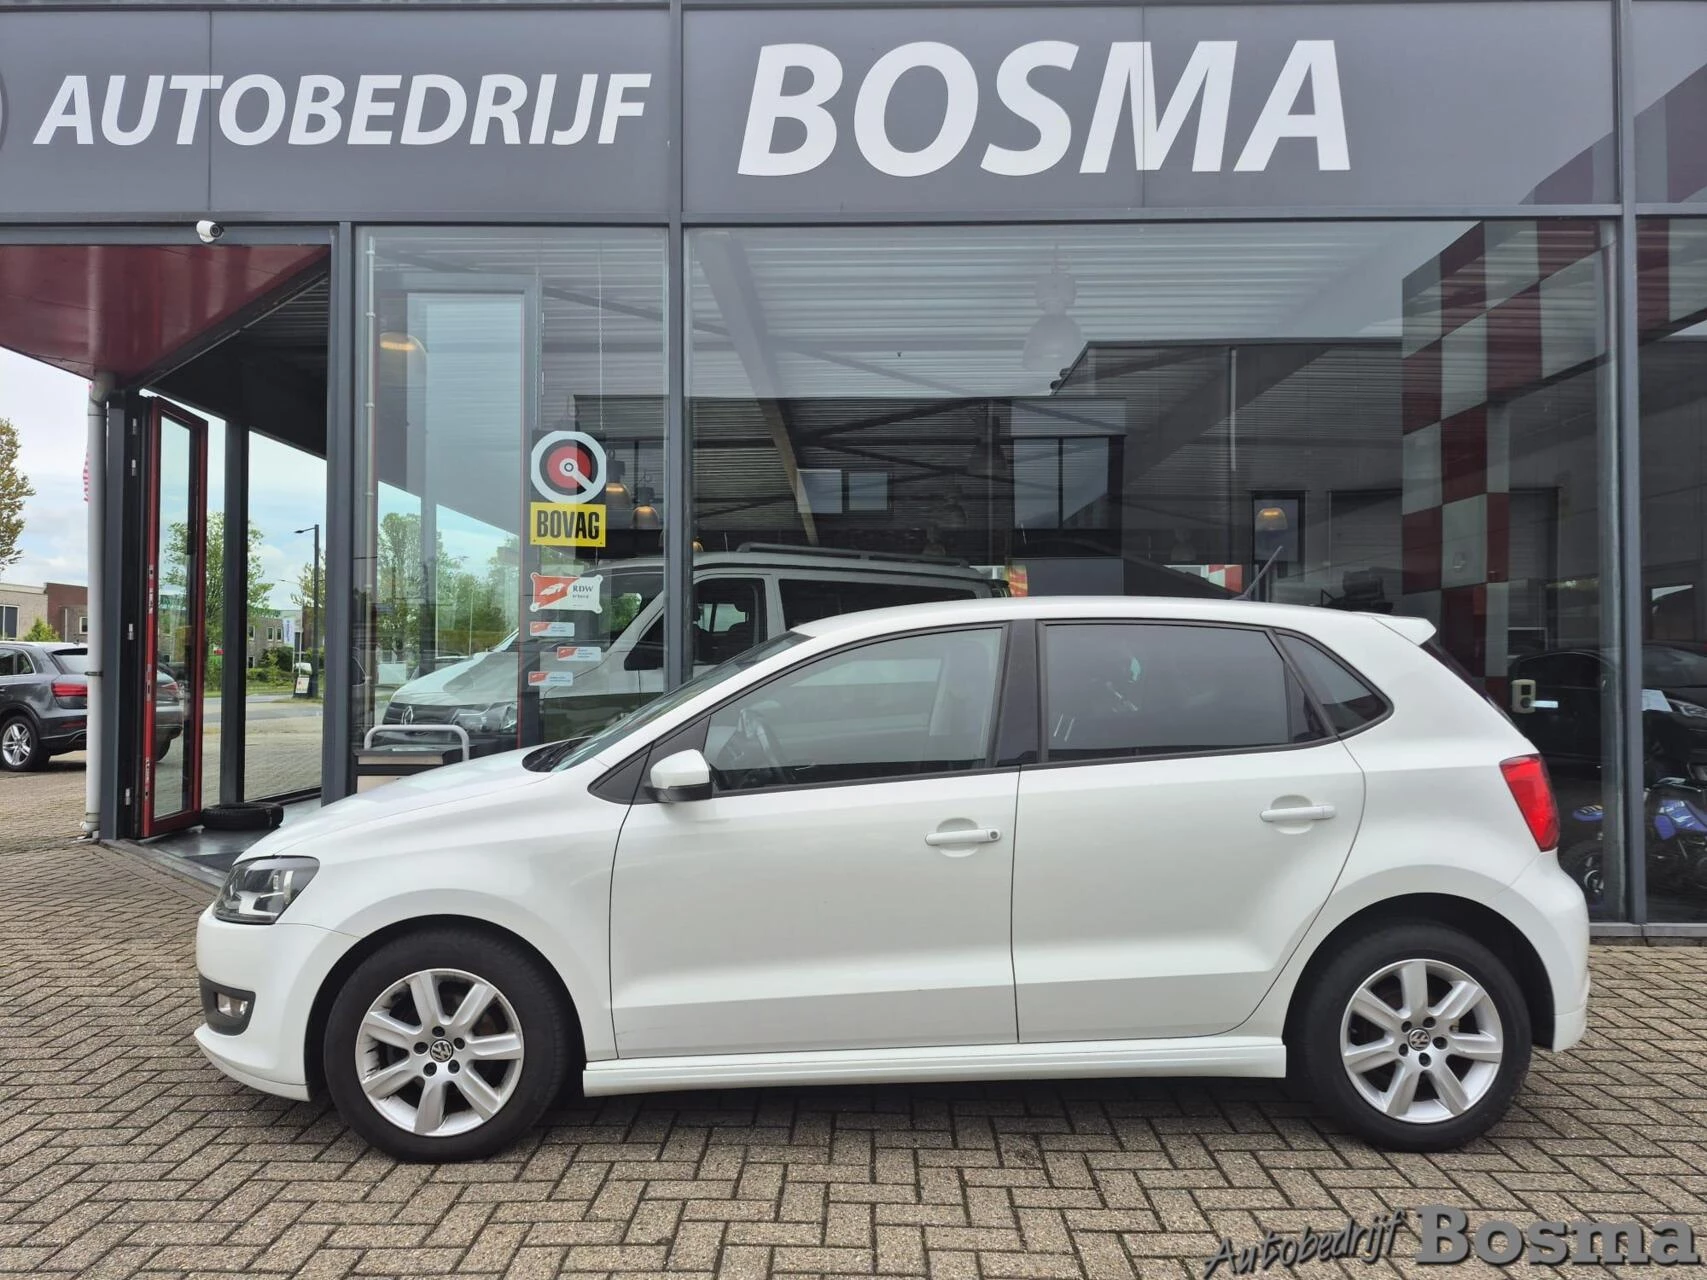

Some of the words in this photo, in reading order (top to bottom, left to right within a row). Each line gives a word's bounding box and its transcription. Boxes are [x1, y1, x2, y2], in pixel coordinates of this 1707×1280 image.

[33, 73, 652, 146] AUTOBEDRIJF
[737, 39, 1351, 177] BOSMA
[537, 509, 600, 540] BOVAG
[572, 585, 594, 593] RDW
